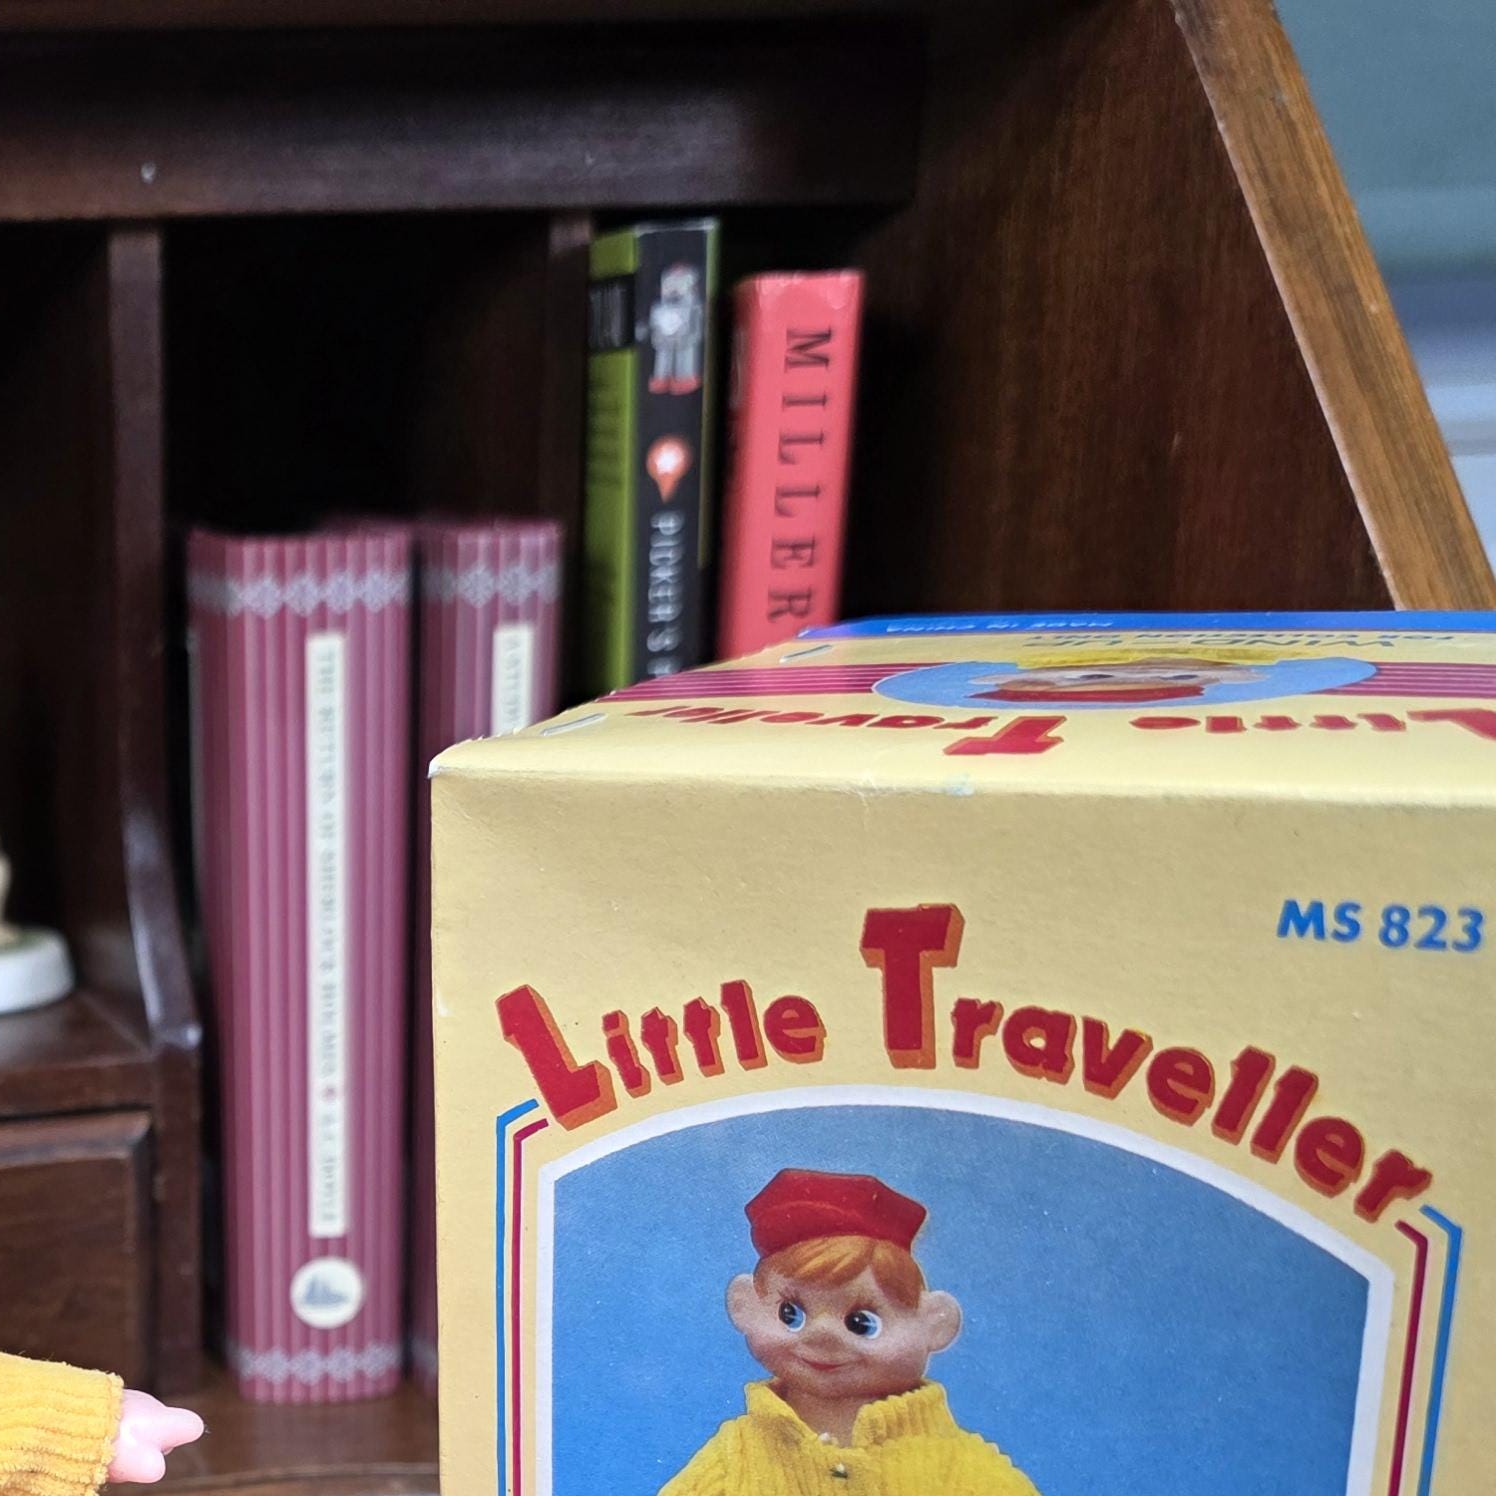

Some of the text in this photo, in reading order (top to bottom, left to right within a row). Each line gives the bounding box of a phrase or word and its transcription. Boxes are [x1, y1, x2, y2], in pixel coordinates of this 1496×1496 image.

[766, 327, 834, 624] MILLER
[624, 705, 1067, 755] Traveller
[1276, 898, 1485, 952] MS 823
[495, 902, 1434, 1224] Little Traveller
